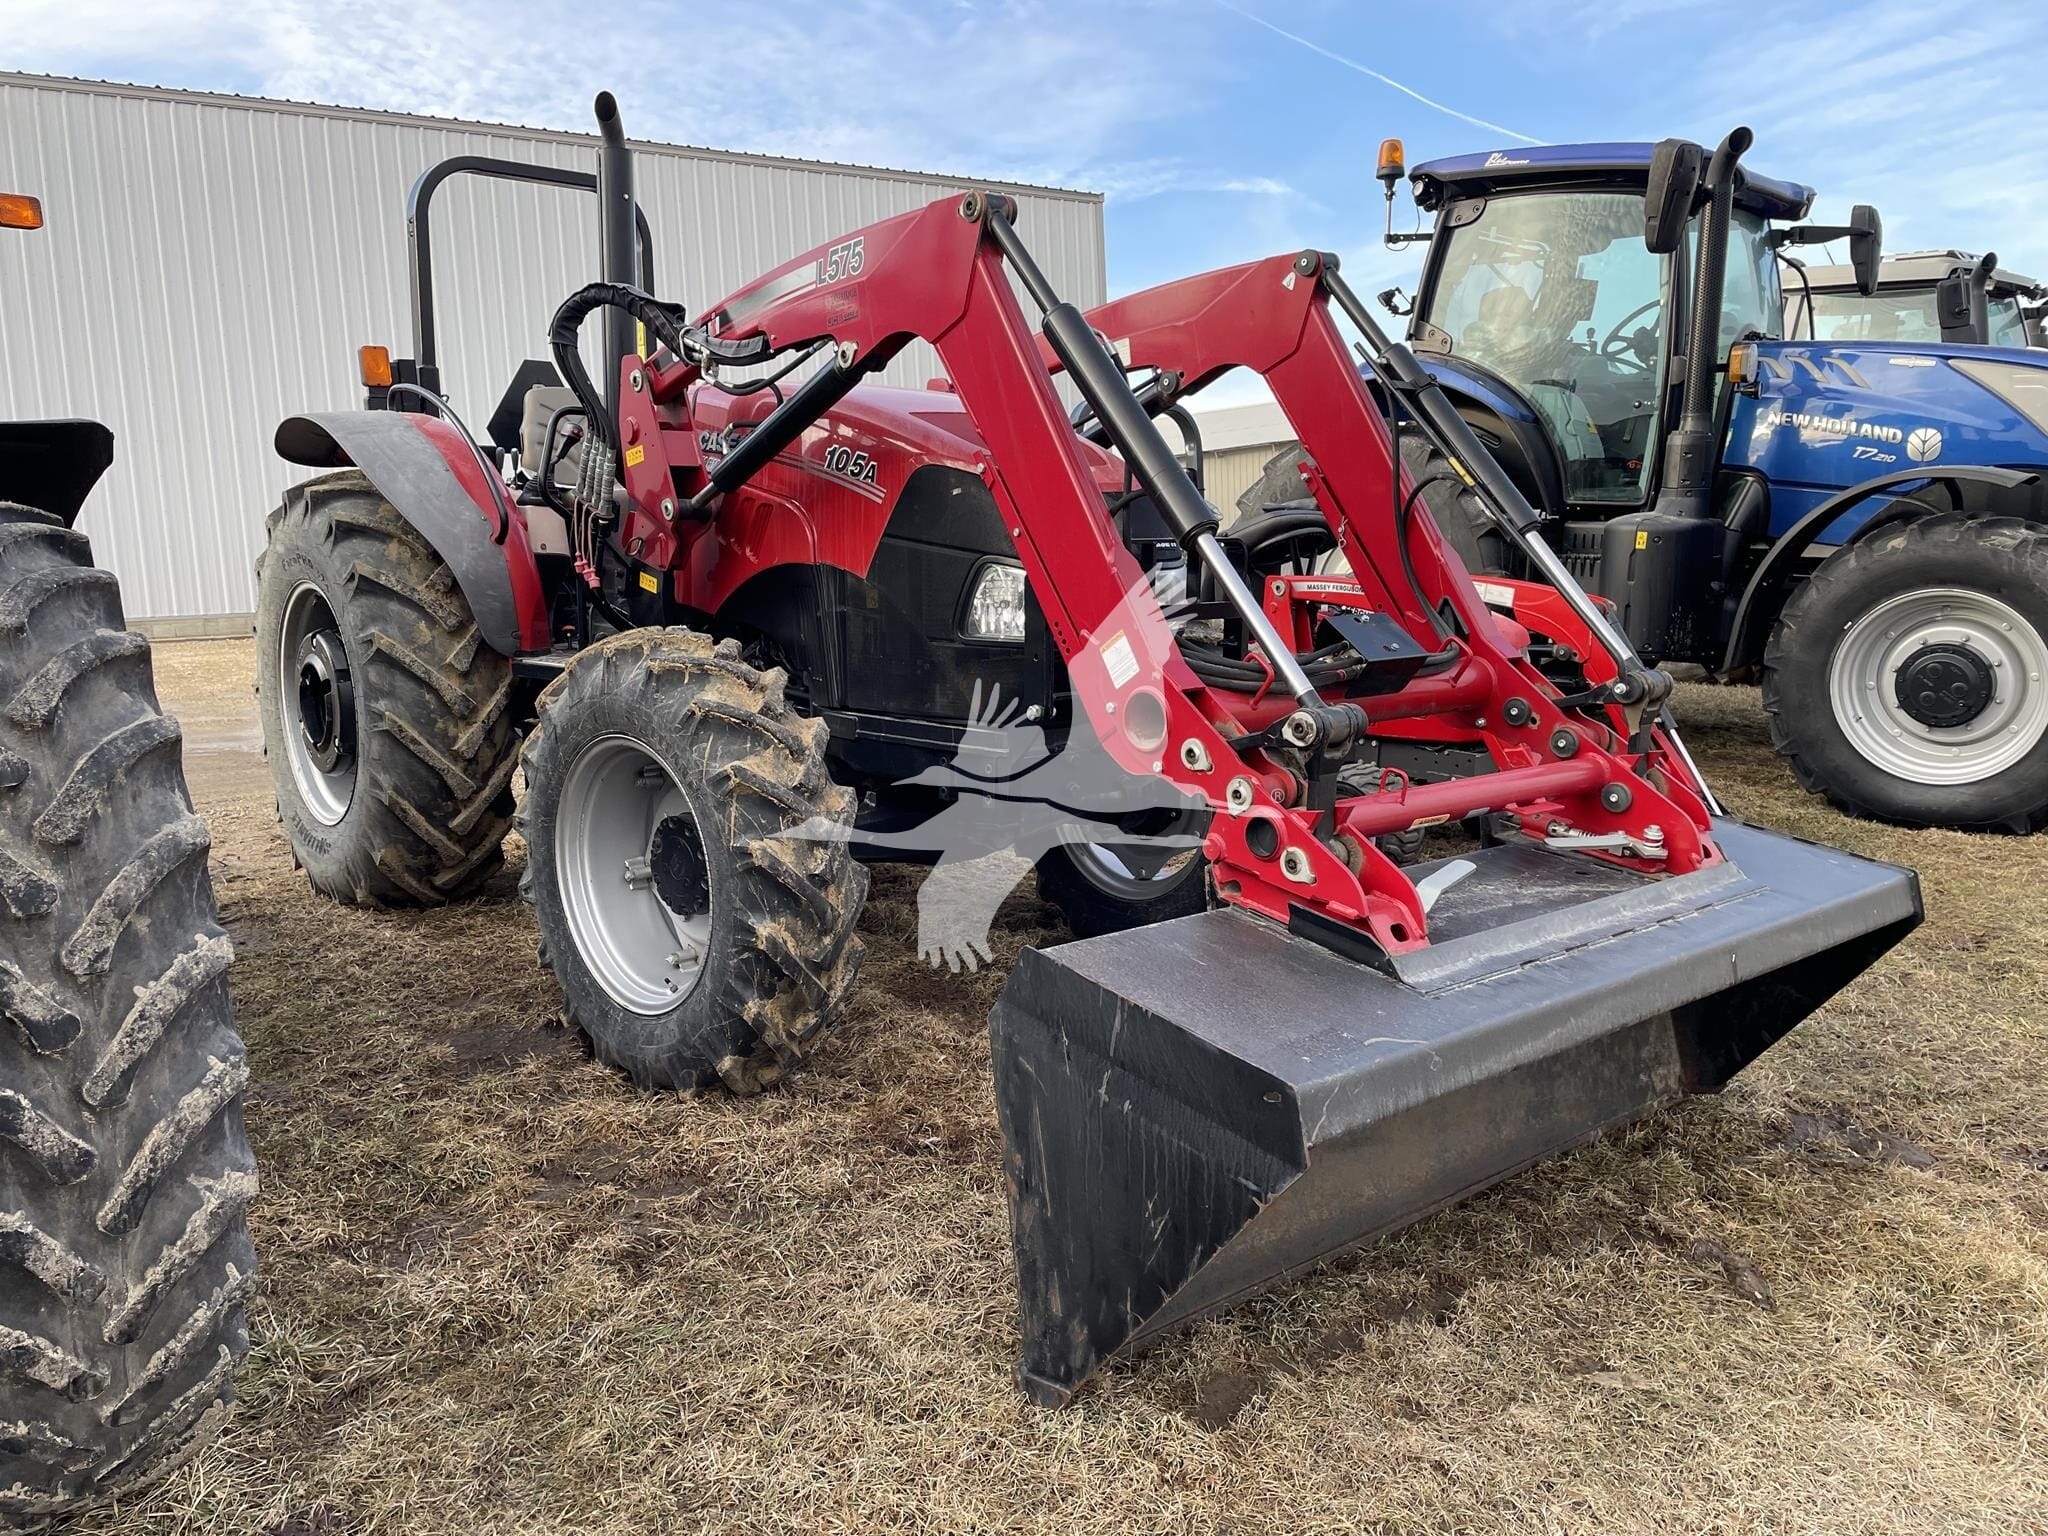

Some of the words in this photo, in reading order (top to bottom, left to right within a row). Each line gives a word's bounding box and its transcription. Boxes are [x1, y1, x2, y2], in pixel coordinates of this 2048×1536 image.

[817, 236, 864, 288] L575
[1767, 411, 1810, 429] NEW
[1813, 413, 1903, 444] HOLLAND
[824, 444, 878, 485] 105A
